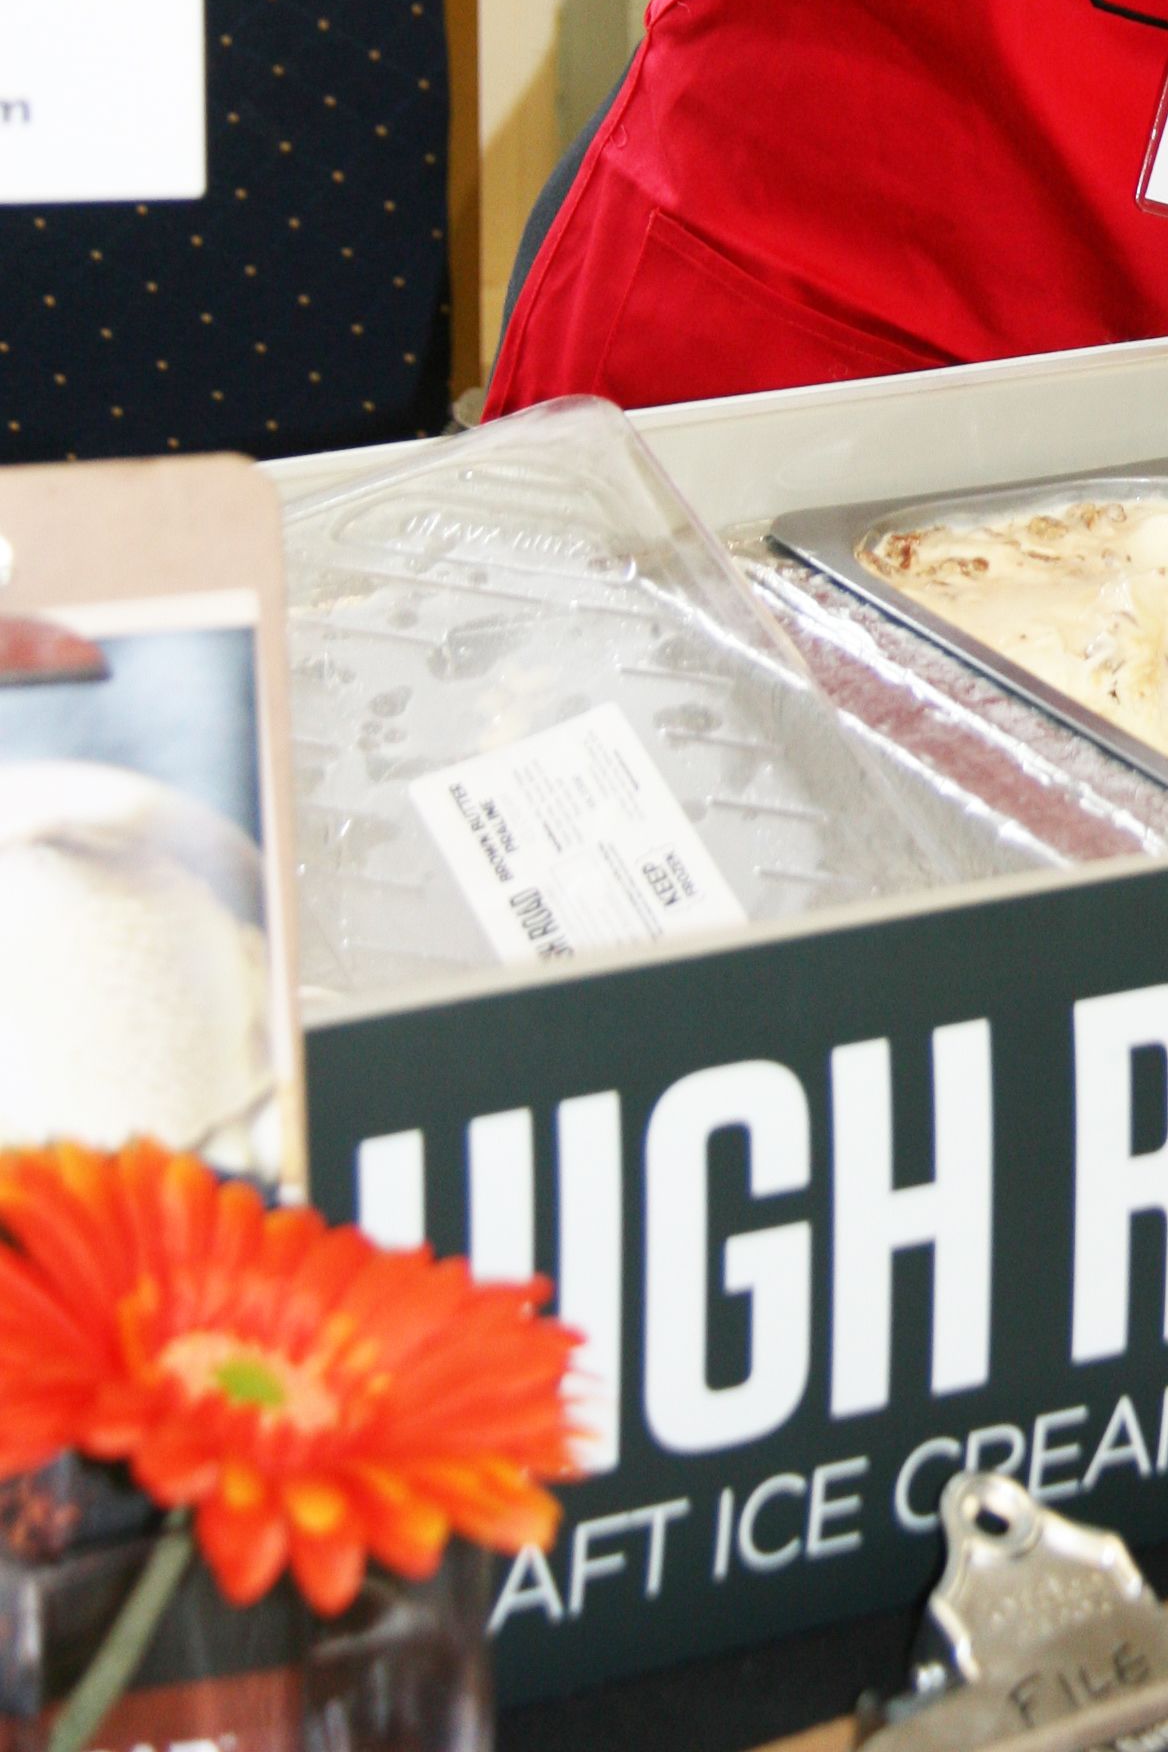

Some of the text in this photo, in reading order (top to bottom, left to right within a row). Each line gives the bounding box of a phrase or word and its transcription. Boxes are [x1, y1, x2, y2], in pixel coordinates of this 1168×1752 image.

[641, 862, 681, 907] KEEP
[485, 1496, 691, 1637] AFT
[711, 1455, 871, 1583] ICE
[1006, 1640, 1150, 1730] FILE
